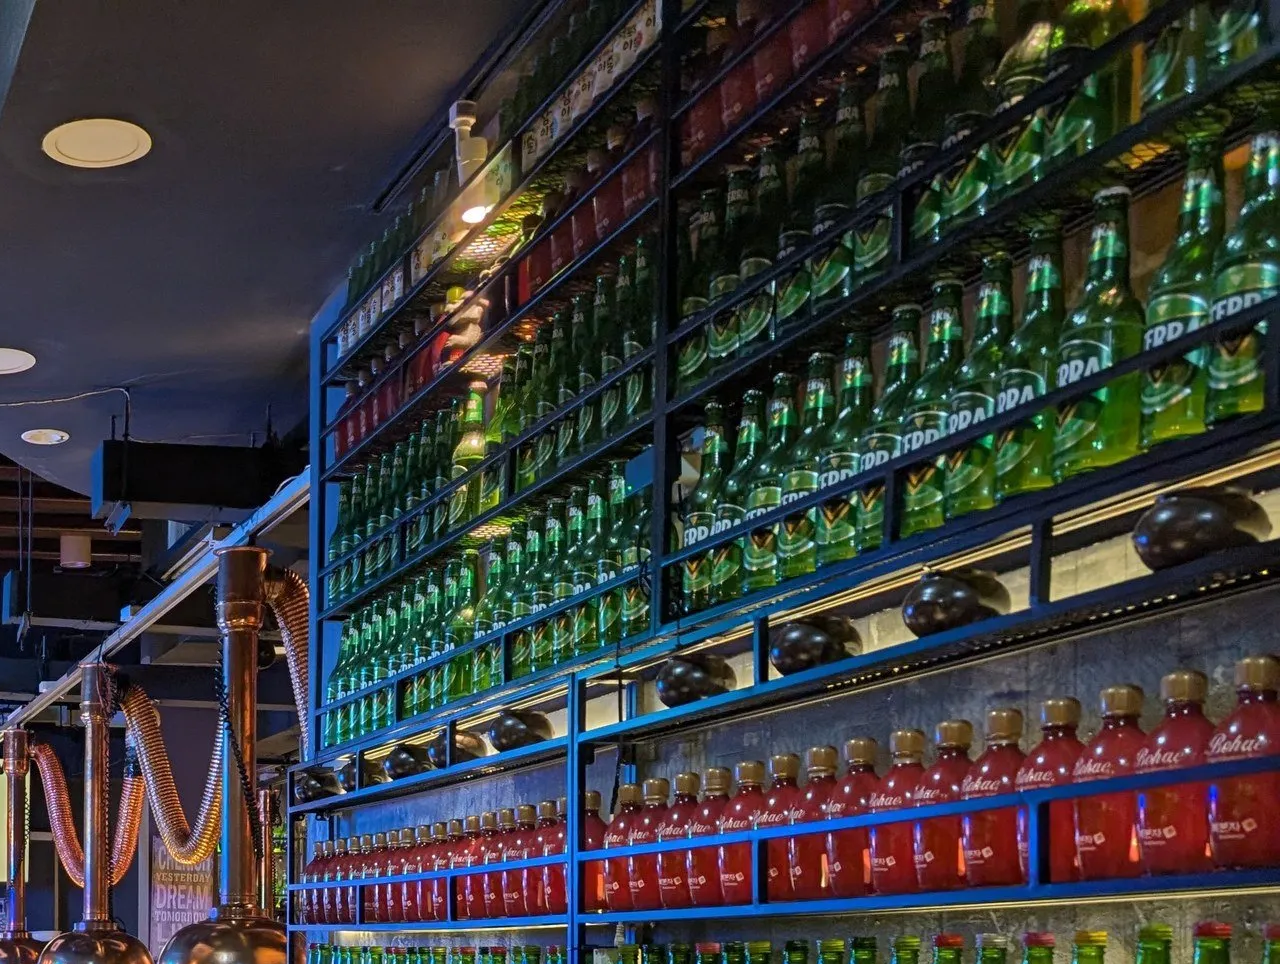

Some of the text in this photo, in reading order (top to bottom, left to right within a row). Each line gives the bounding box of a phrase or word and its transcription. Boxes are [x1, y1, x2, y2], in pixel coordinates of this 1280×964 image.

[1209, 733, 1265, 753] Bohae
[156, 872, 210, 882] YESTERDAY
[157, 884, 208, 909] DREAM
